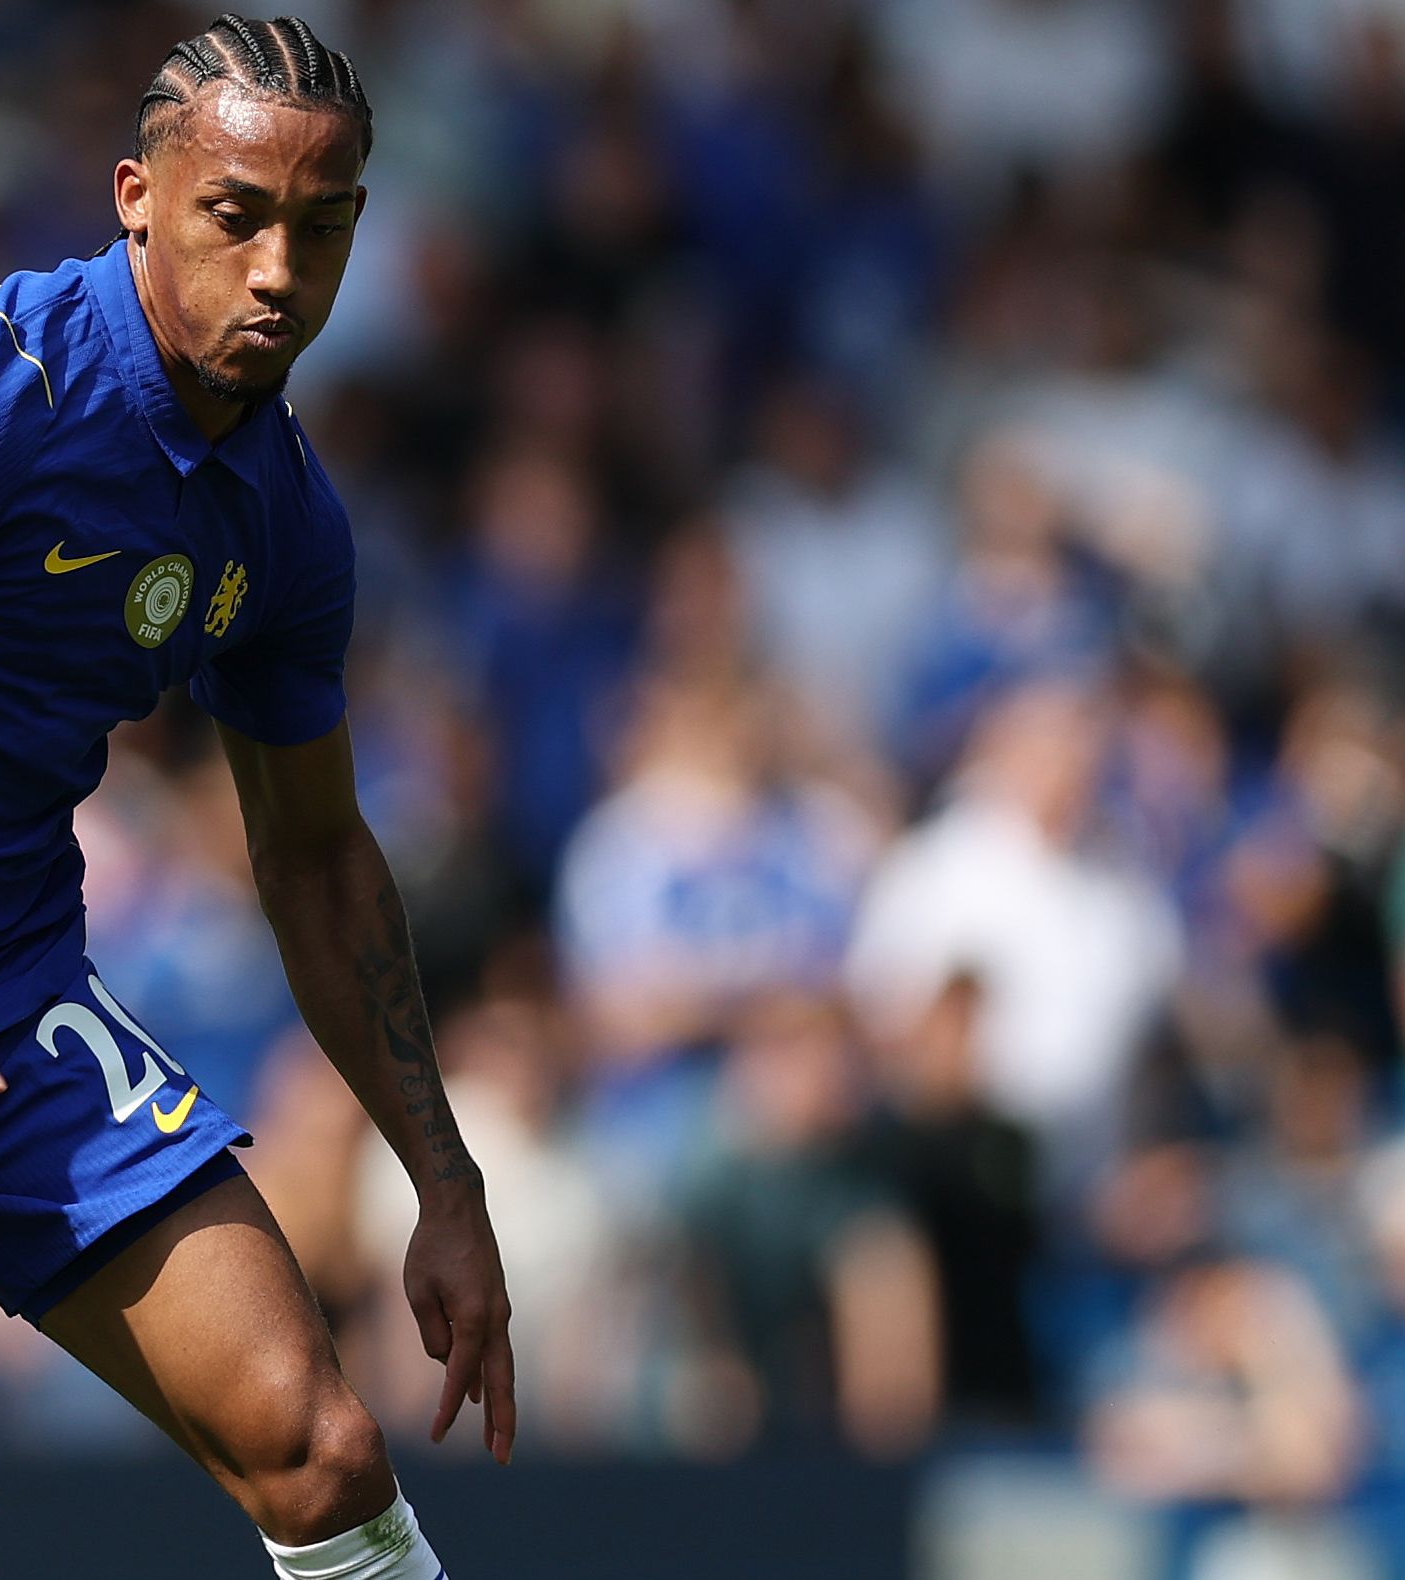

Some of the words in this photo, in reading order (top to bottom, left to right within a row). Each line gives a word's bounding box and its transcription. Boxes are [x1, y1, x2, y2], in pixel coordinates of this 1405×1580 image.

[134, 565, 165, 603] WORLD
[167, 562, 190, 617] CHAMPIONS
[138, 623, 163, 641] FIFA
